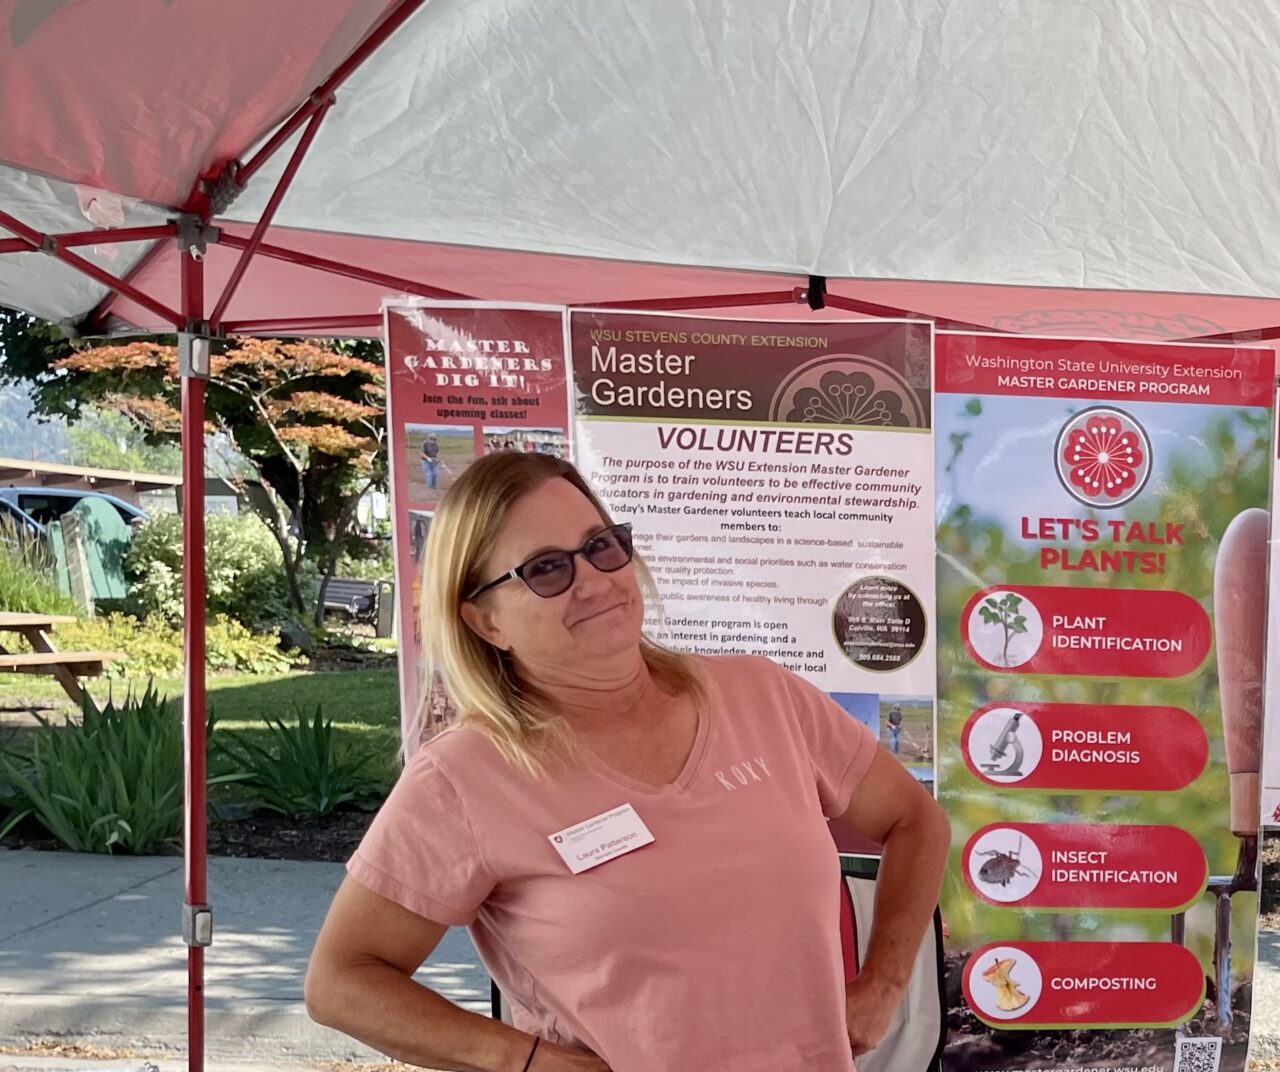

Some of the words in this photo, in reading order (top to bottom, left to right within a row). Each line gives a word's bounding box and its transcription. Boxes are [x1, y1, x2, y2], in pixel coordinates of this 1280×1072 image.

[425, 339, 530, 353] MASTER
[590, 329, 623, 343] WSU
[626, 331, 687, 344] STEVENS
[691, 333, 747, 346] COUNTY
[751, 335, 828, 348] EXTENSION
[404, 355, 552, 371] GARDENERS
[591, 346, 695, 375] Master
[965, 355, 1054, 371] Washington
[1057, 359, 1096, 372] State
[1099, 361, 1170, 378] University
[1173, 363, 1243, 379] Extension
[435, 373, 480, 386] DIG
[489, 374, 525, 389] IT!
[998, 375, 1054, 389] MASTER
[1057, 377, 1136, 392] GARDENER
[1139, 381, 1211, 396] PROGRAM
[423, 393, 443, 403] Join
[447, 394, 463, 404] the
[491, 395, 509, 405] ask
[512, 396, 539, 406] about
[591, 378, 753, 411] Gardeners
[437, 409, 486, 420] upcoming
[490, 409, 527, 419] classes!
[657, 426, 854, 455] VOLUNTEERS
[602, 457, 627, 468] The
[629, 460, 675, 472] purpose
[678, 459, 690, 469] of
[693, 460, 713, 470] the
[715, 461, 745, 471] WSU
[748, 462, 806, 474] Extension
[811, 464, 851, 476] Master
[854, 466, 910, 478] Gardener
[591, 472, 640, 486] Program
[643, 474, 654, 483] is
[657, 475, 669, 484] to
[672, 474, 699, 485] train
[702, 476, 765, 488] volunteers
[769, 478, 780, 488] to
[783, 478, 798, 489] be
[802, 479, 852, 491] effective
[855, 483, 921, 495] community
[597, 486, 650, 500] ducators
[654, 489, 664, 499] in
[668, 490, 727, 504] gardening
[731, 491, 753, 502] and
[756, 492, 841, 505] environmental
[844, 496, 920, 510] stewardship.
[609, 503, 645, 515] Today's
[647, 505, 681, 515] Master
[683, 506, 728, 517] Gardener
[731, 507, 782, 518] volunteers
[784, 509, 810, 518] teach
[813, 510, 835, 520] local
[838, 512, 893, 524] community
[720, 521, 765, 532] members
[768, 523, 781, 532] to:
[1021, 516, 1100, 542] LET'S
[1108, 519, 1186, 545] TALK
[1040, 547, 1167, 574] PLANTS!
[664, 618, 709, 627] Gardener
[711, 619, 751, 630] program
[754, 619, 761, 629] is
[763, 620, 788, 631] open
[1052, 615, 1106, 630] PLANT
[656, 632, 669, 640] an
[671, 632, 706, 641] interest
[709, 632, 718, 642] in
[721, 633, 768, 644] gardening
[770, 634, 789, 644] and
[1052, 635, 1183, 652] IDENTIFICATION
[751, 649, 805, 659] experience
[807, 649, 824, 659] and
[805, 663, 827, 673] local
[1051, 731, 1131, 745] PROBLEM
[1051, 749, 1141, 764] DIAGNOSIS
[714, 756, 771, 792] ROXY
[576, 847, 600, 861] Laura
[600, 831, 638, 850] Patterson
[1051, 850, 1108, 864] INSECT
[1051, 869, 1178, 884] IDENTIFICATION
[1051, 976, 1157, 990] COMPOSTING
